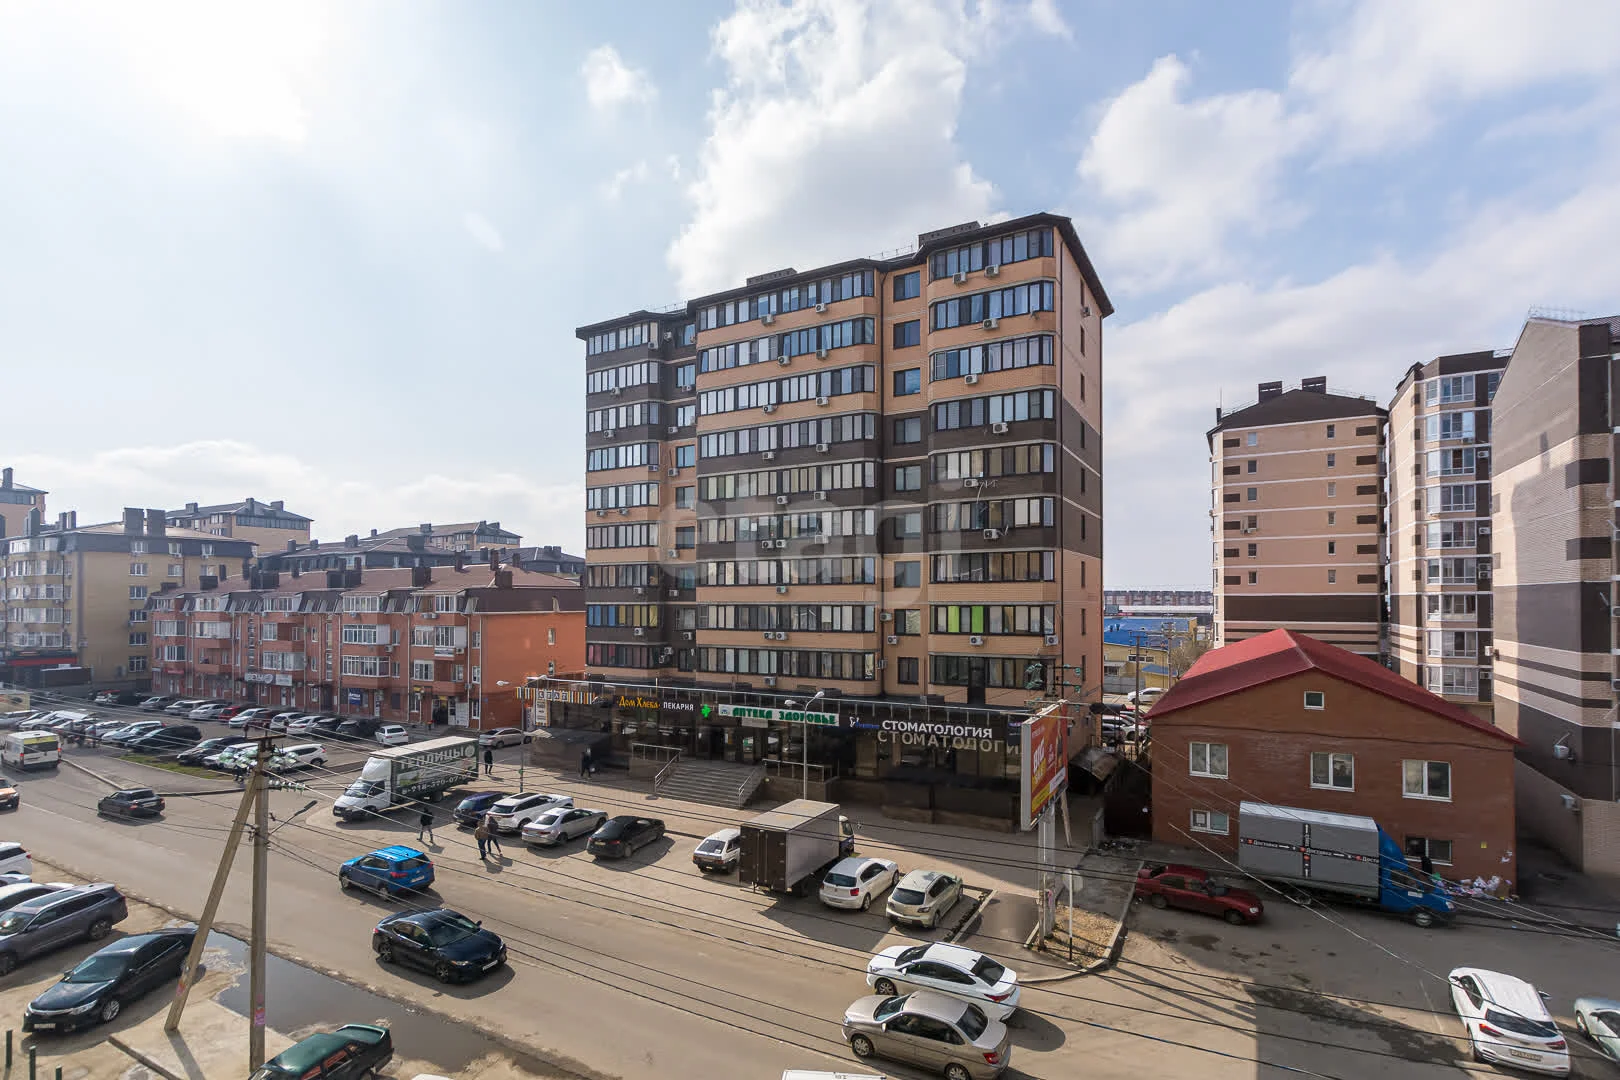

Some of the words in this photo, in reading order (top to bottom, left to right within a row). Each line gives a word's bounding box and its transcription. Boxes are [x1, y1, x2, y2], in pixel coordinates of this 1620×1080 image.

[663, 701, 694, 711] ПЕКАРНЯ
[732, 707, 772, 719] АПТЕКА
[882, 720, 993, 738] СТОМАТОЛОГИЯ
